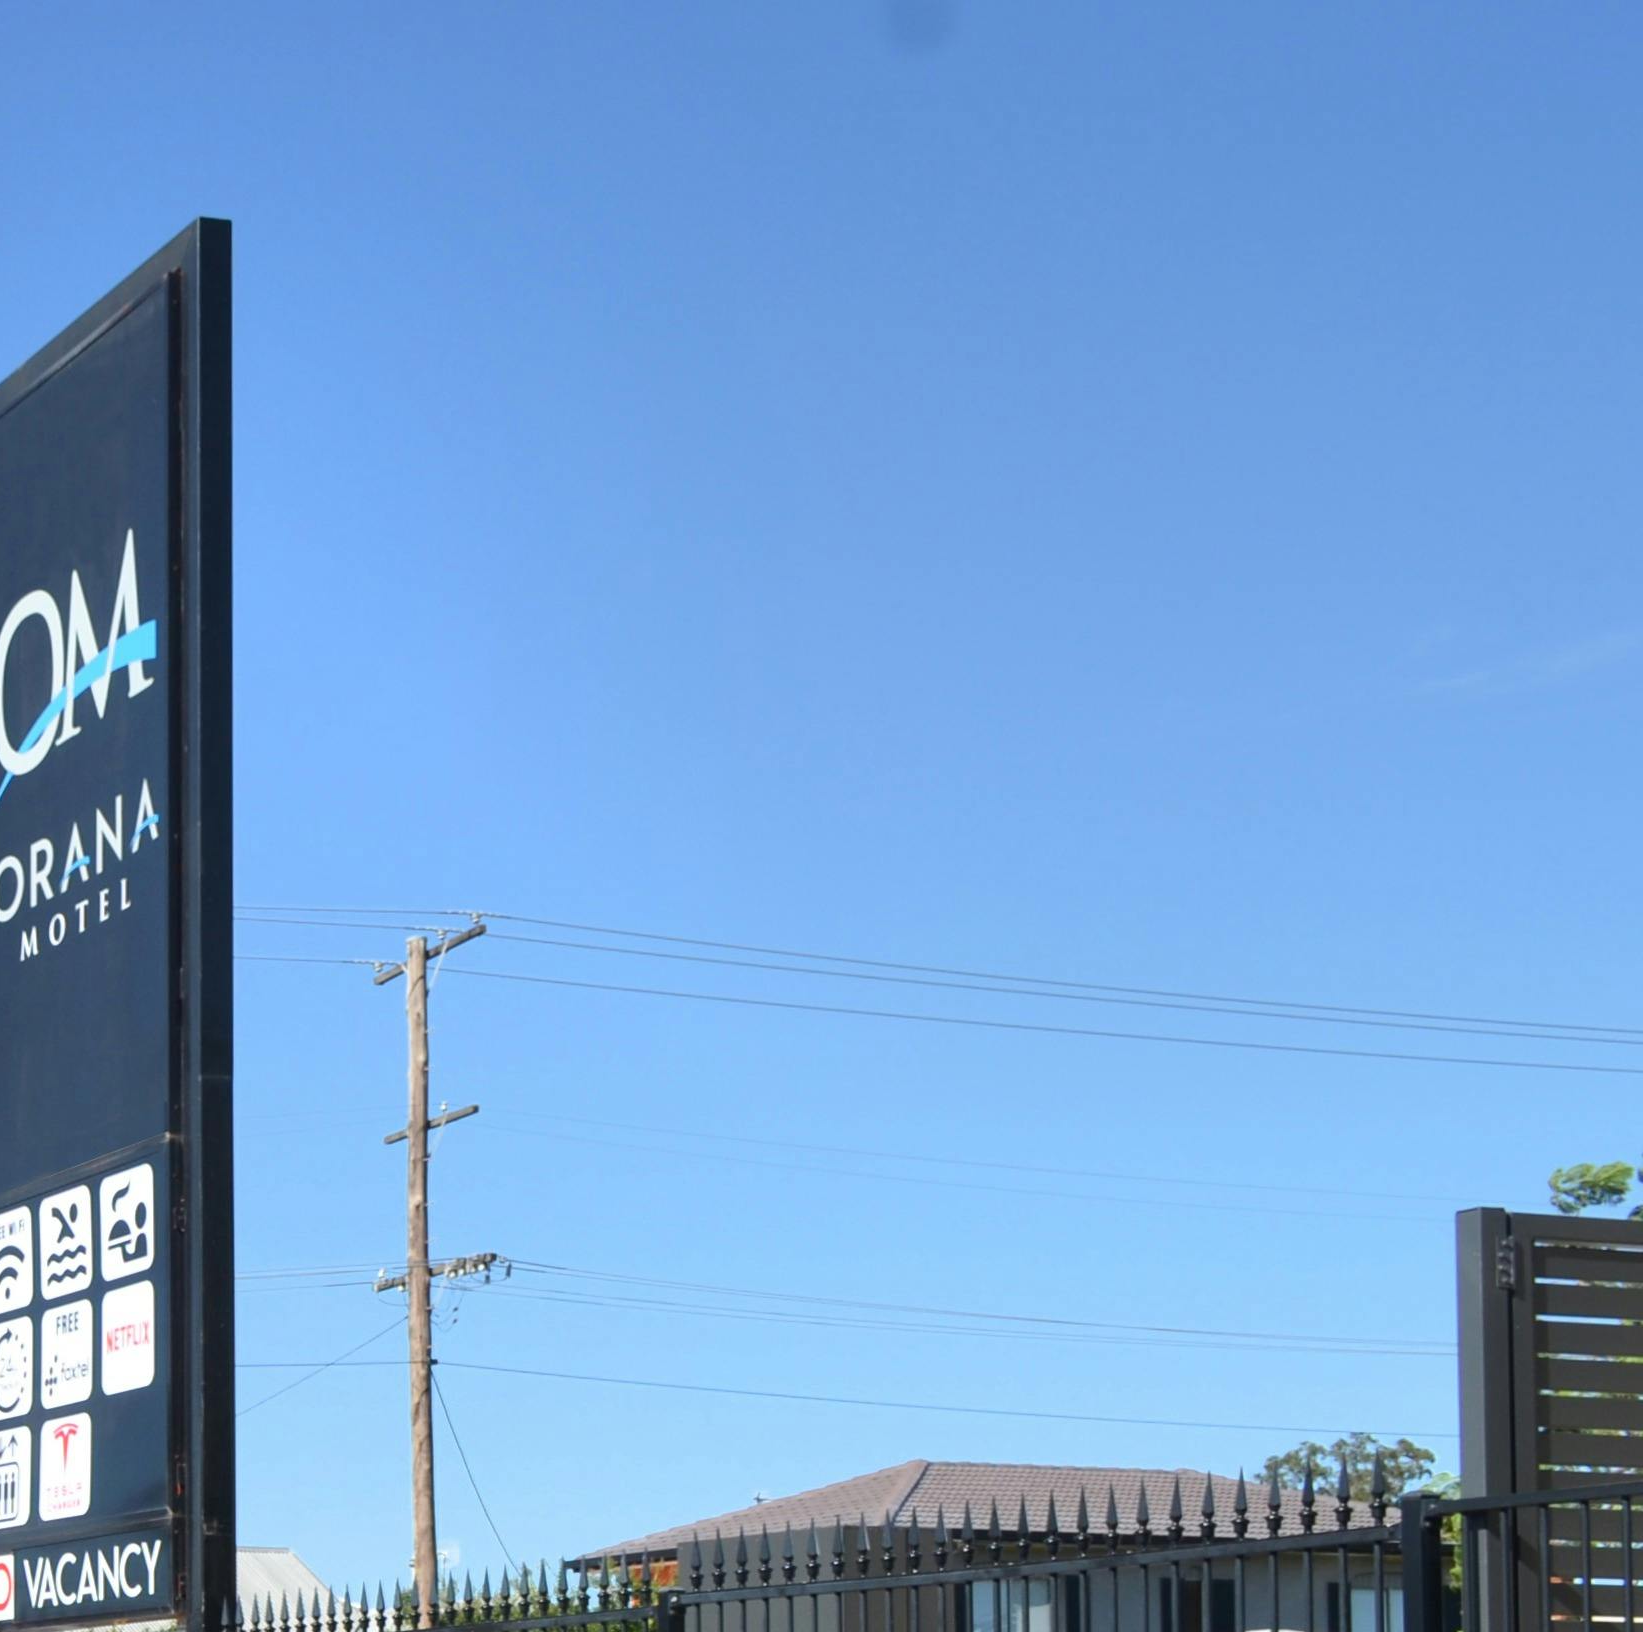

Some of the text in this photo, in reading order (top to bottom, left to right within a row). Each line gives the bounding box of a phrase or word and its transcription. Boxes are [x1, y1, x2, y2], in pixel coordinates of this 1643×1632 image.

[19, 877, 132, 962] MOTEL
[55, 1311, 79, 1336] FREE
[106, 1319, 150, 1355] NETFLIX
[60, 1355, 90, 1381] foxtel
[22, 1539, 162, 1609] VACANCY
